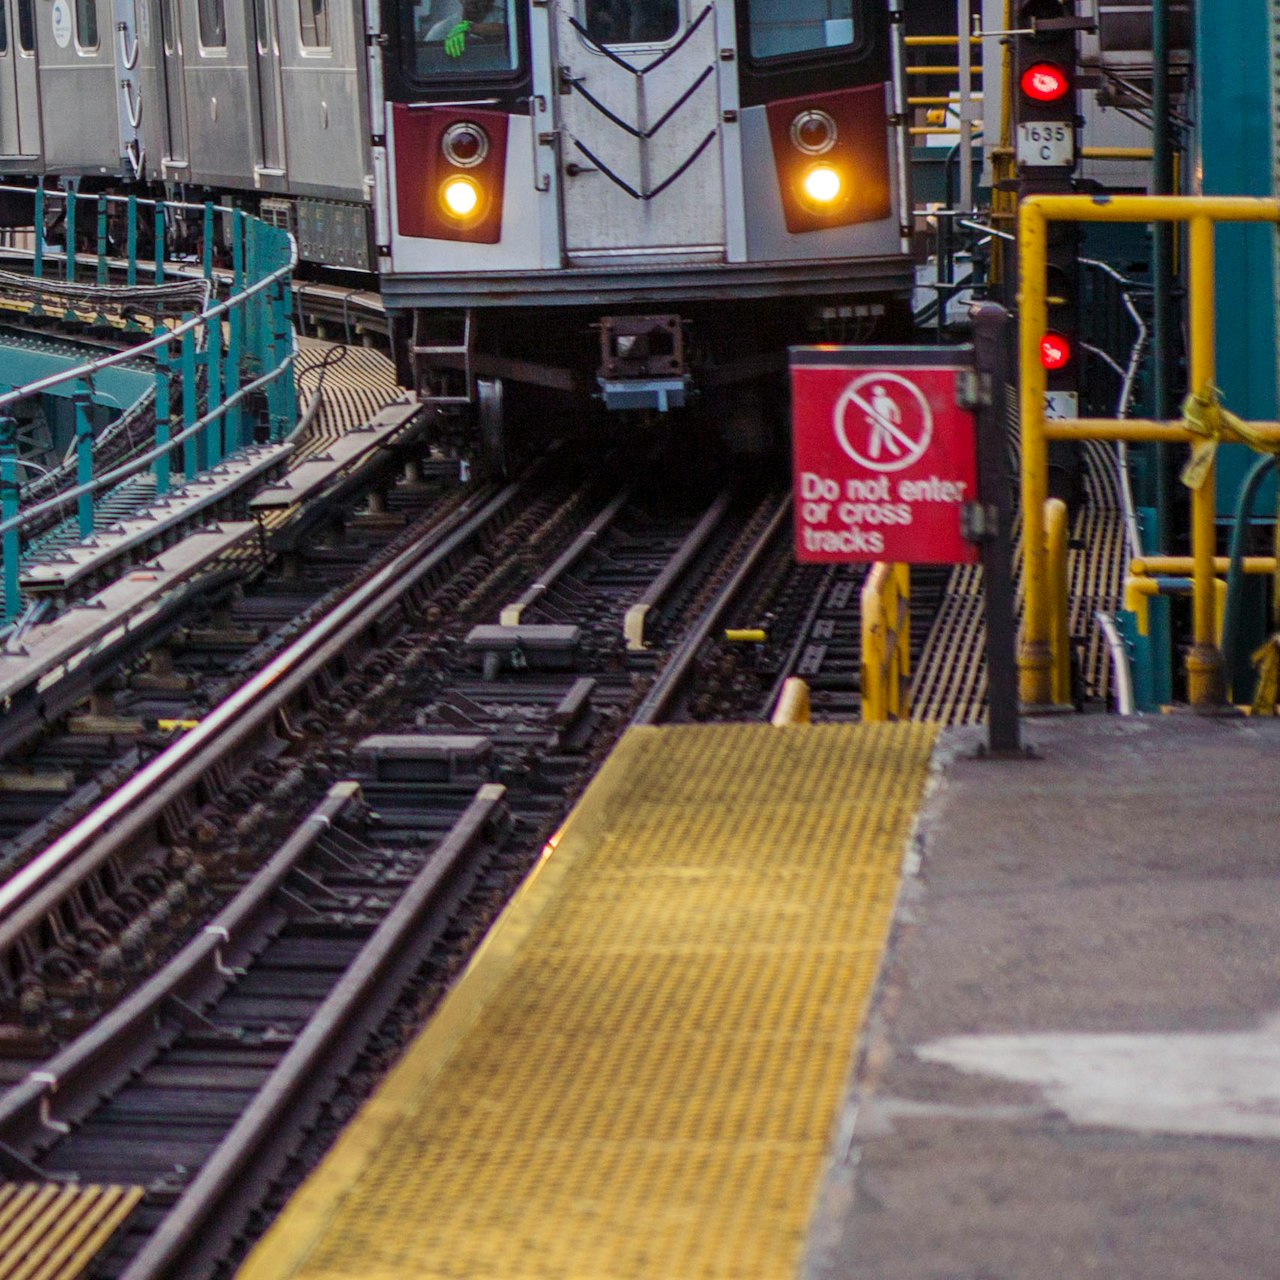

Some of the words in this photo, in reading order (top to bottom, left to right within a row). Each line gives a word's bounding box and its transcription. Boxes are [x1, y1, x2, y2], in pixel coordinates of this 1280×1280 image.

[1024, 127, 1065, 142] 1635
[1039, 145, 1051, 160] C
[800, 472, 840, 500] Do
[846, 475, 890, 501] not
[897, 476, 967, 503] enter
[802, 502, 832, 524] or
[838, 502, 913, 526] cross
[803, 526, 885, 553] tracks
